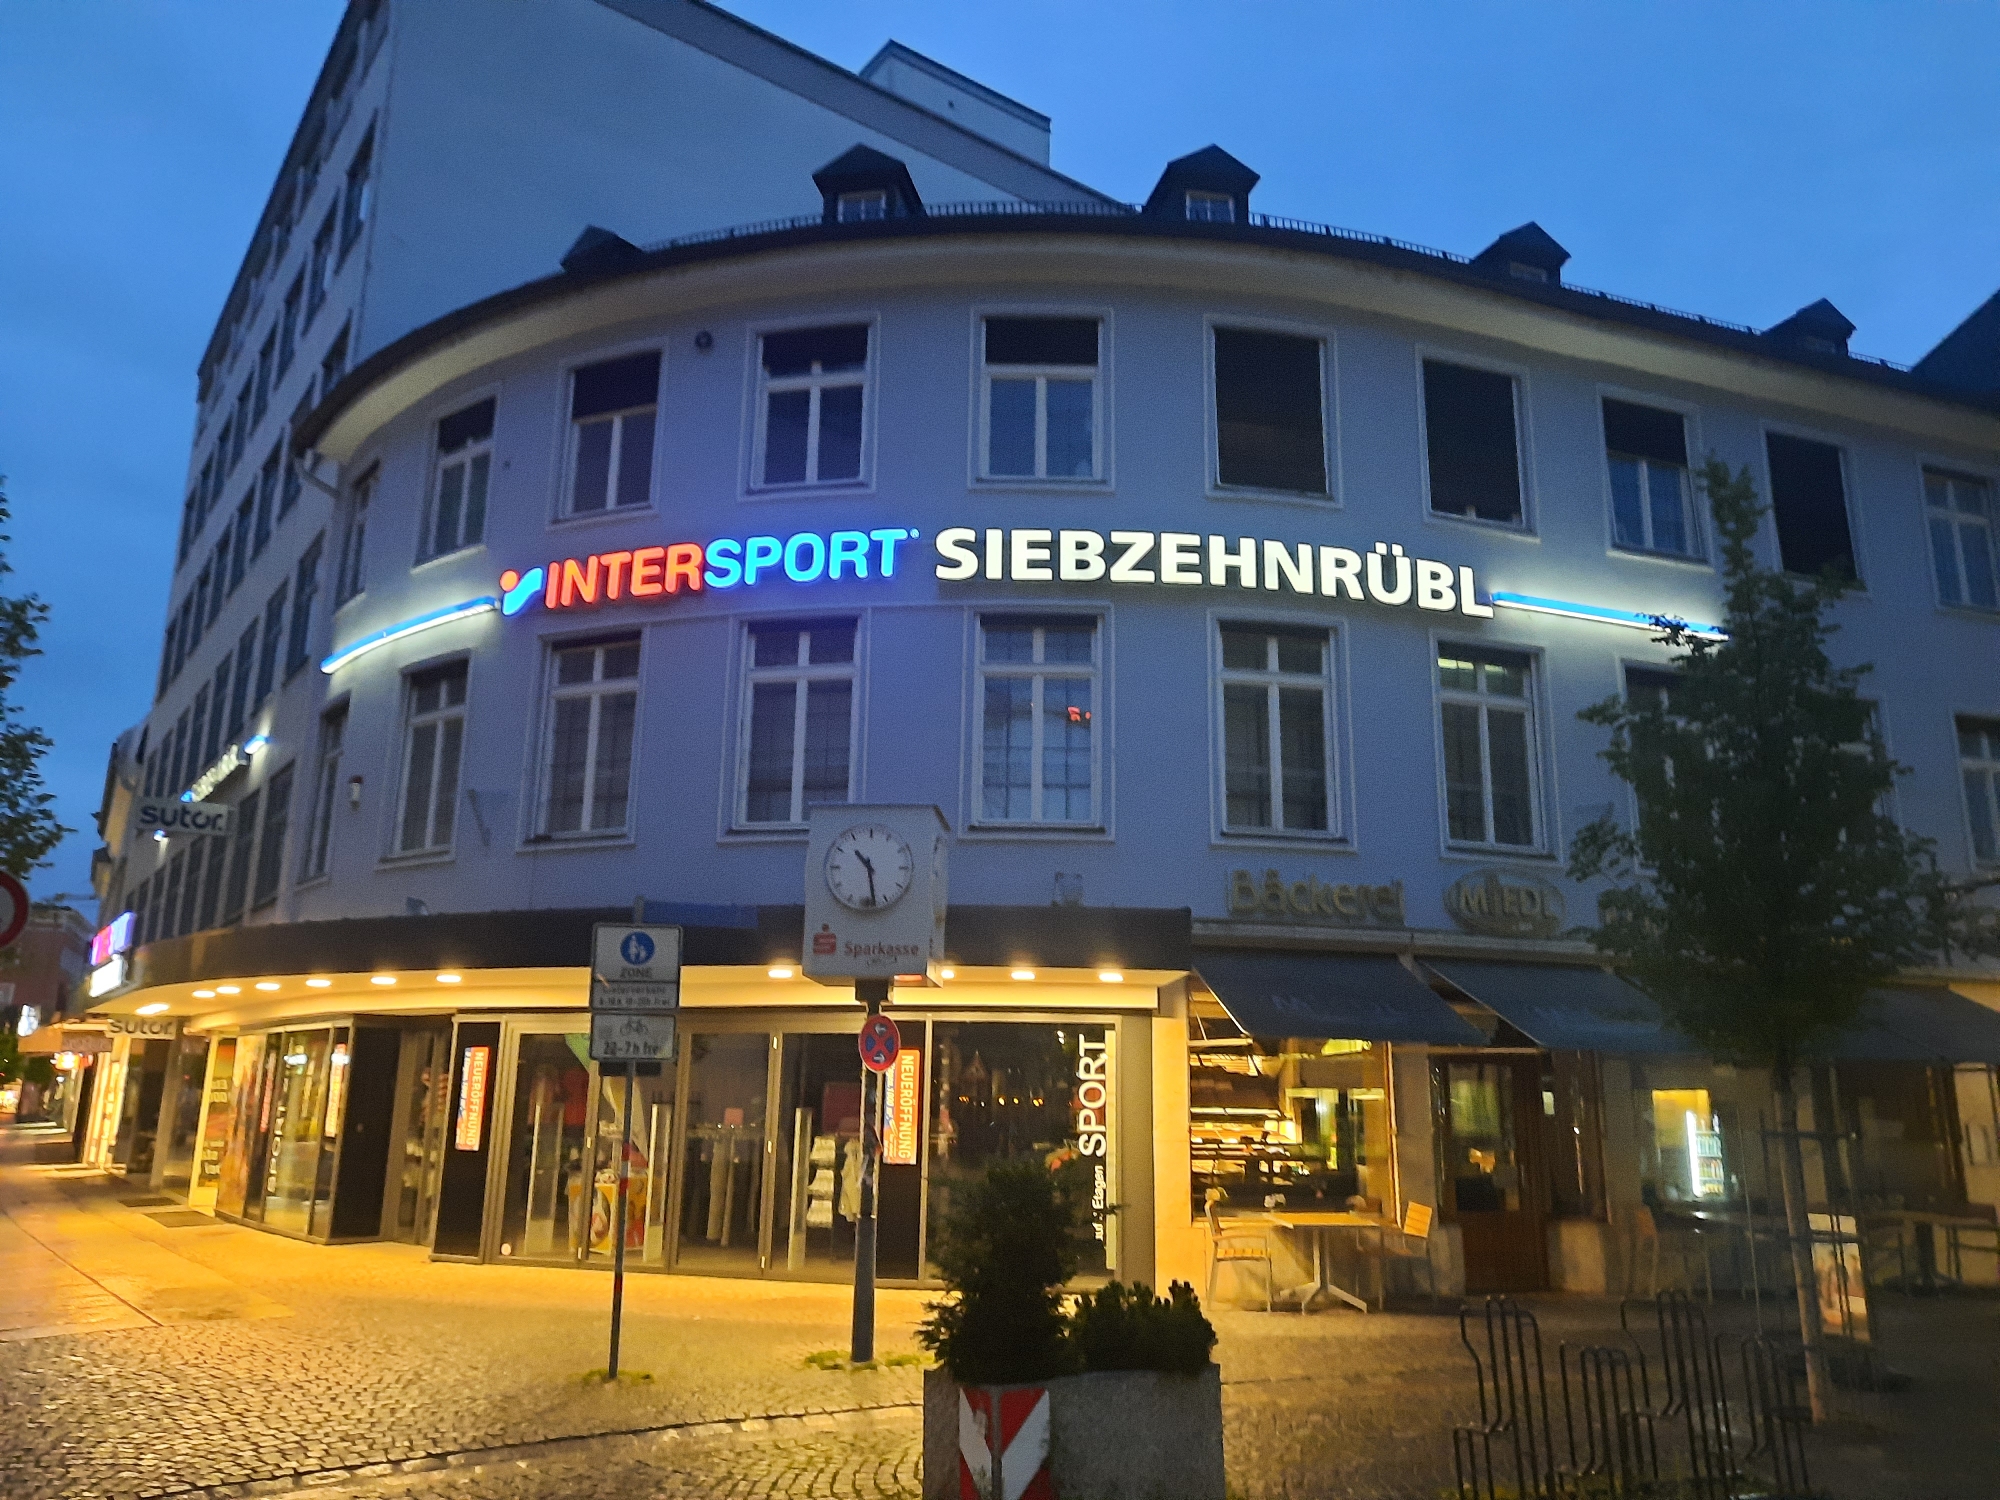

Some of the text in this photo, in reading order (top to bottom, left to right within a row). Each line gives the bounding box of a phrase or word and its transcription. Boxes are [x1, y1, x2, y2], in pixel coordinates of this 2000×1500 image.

[544, 527, 1494, 619] INTERSPORT SIEBZEHNRÜBL
[1231, 867, 1404, 922] Bäckerei
[620, 966, 653, 978] ZONE
[844, 941, 919, 957] Sparkasse
[898, 1055, 916, 1159] NEUERÖFFNUNG
[1078, 1033, 1107, 1157] SPORT
[1092, 1165, 1106, 1209] Etagen
